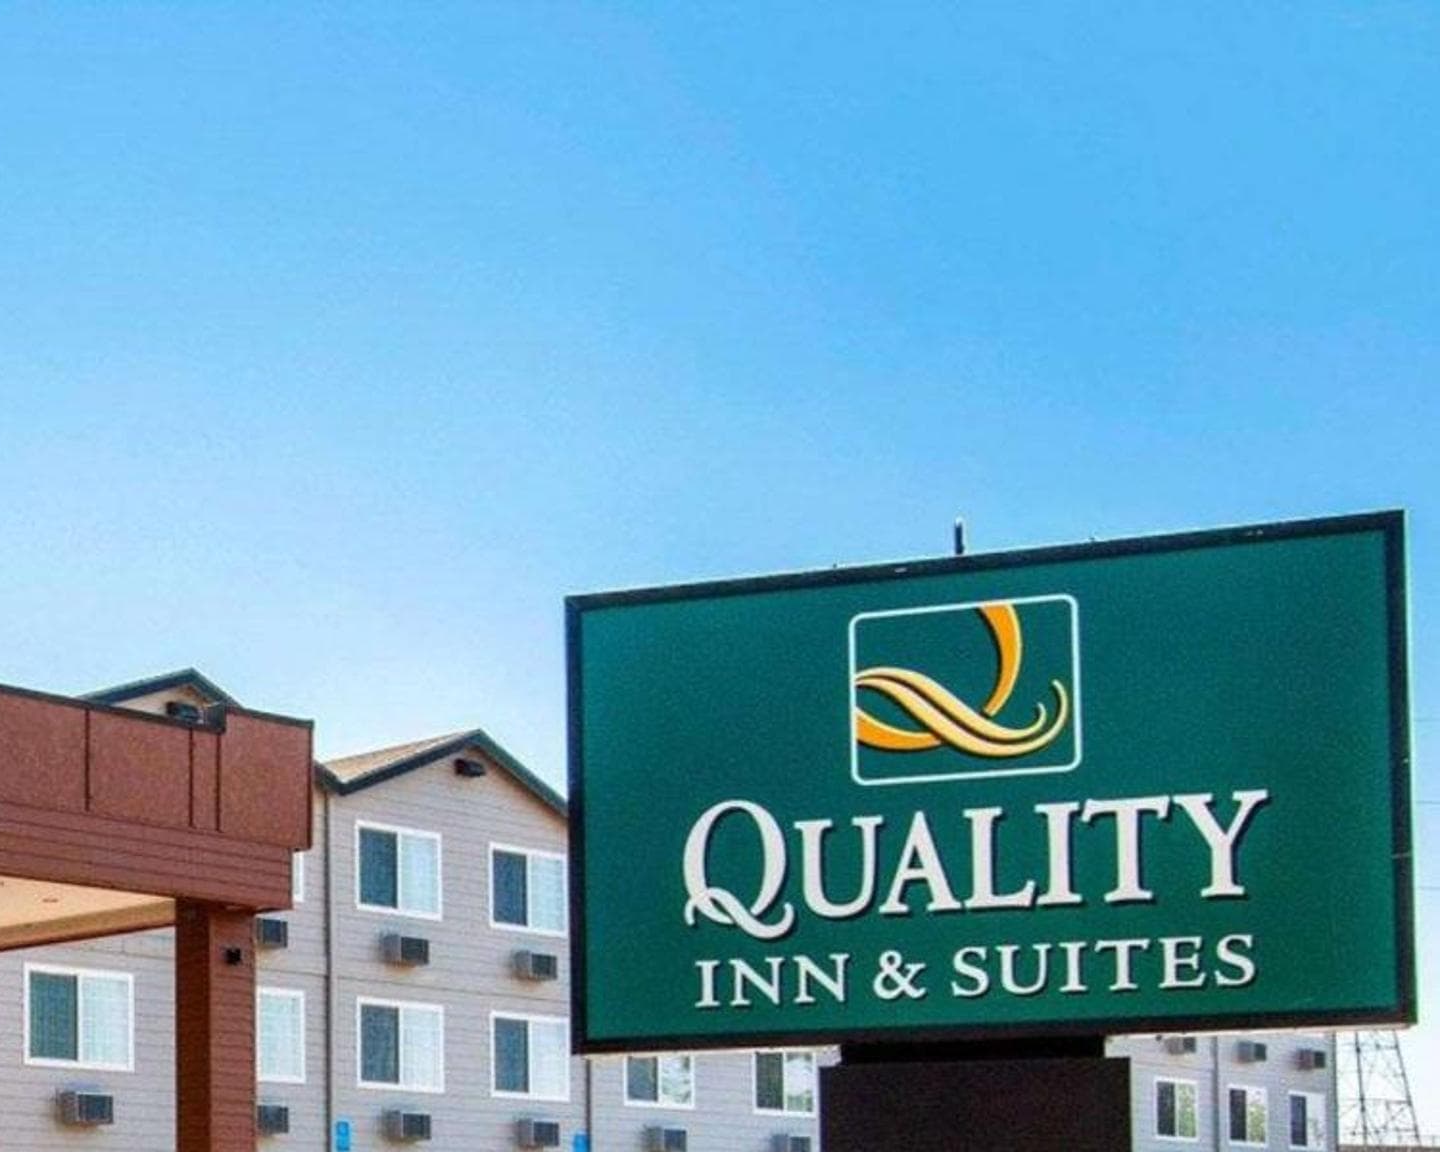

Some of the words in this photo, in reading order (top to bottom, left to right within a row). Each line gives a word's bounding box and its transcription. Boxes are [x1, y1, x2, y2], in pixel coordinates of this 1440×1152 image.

[682, 788, 1269, 940] QUALITY
[694, 953, 851, 1008] INN
[872, 949, 928, 1001] &
[950, 933, 1258, 997] SUITES
